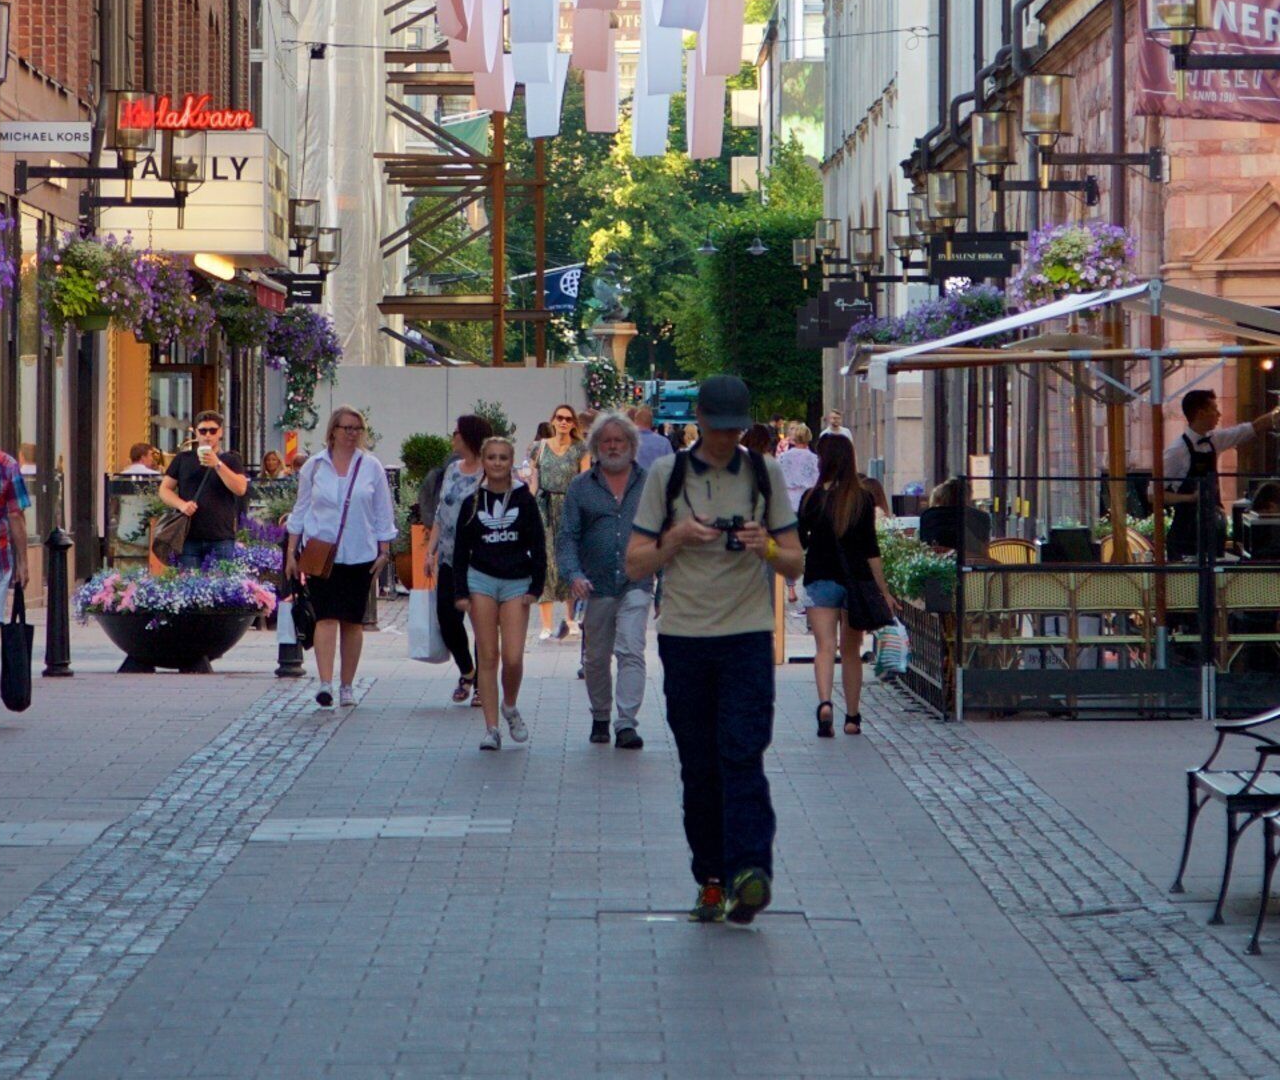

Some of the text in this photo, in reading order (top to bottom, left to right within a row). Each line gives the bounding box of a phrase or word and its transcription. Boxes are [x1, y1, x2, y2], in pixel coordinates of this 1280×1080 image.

[0, 132, 91, 142] MICHAEL KORS
[482, 530, 519, 543] adida
